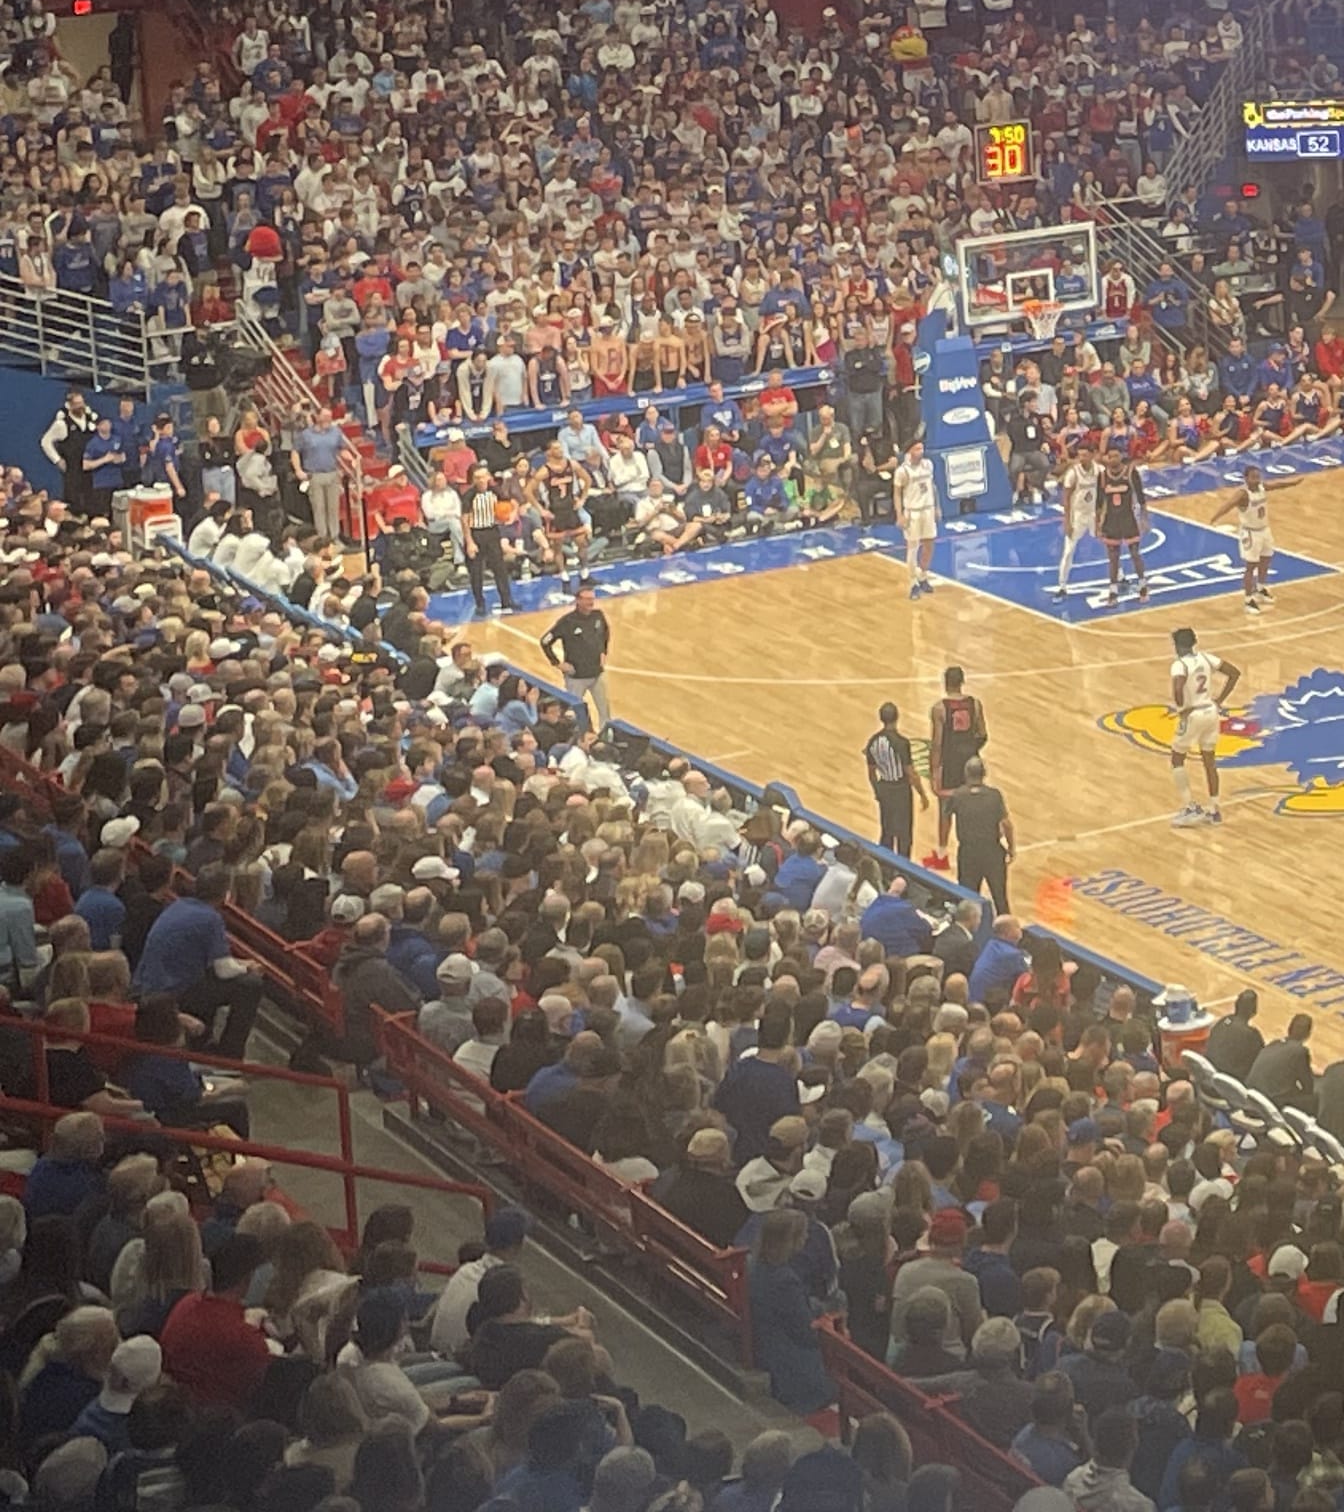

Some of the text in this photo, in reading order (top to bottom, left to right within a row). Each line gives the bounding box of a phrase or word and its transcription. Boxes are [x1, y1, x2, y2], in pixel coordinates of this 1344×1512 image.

[1247, 138, 1297, 153] KANSAS
[1307, 136, 1330, 152] 52
[985, 143, 1023, 177] 30
[1195, 674, 1208, 694] 2
